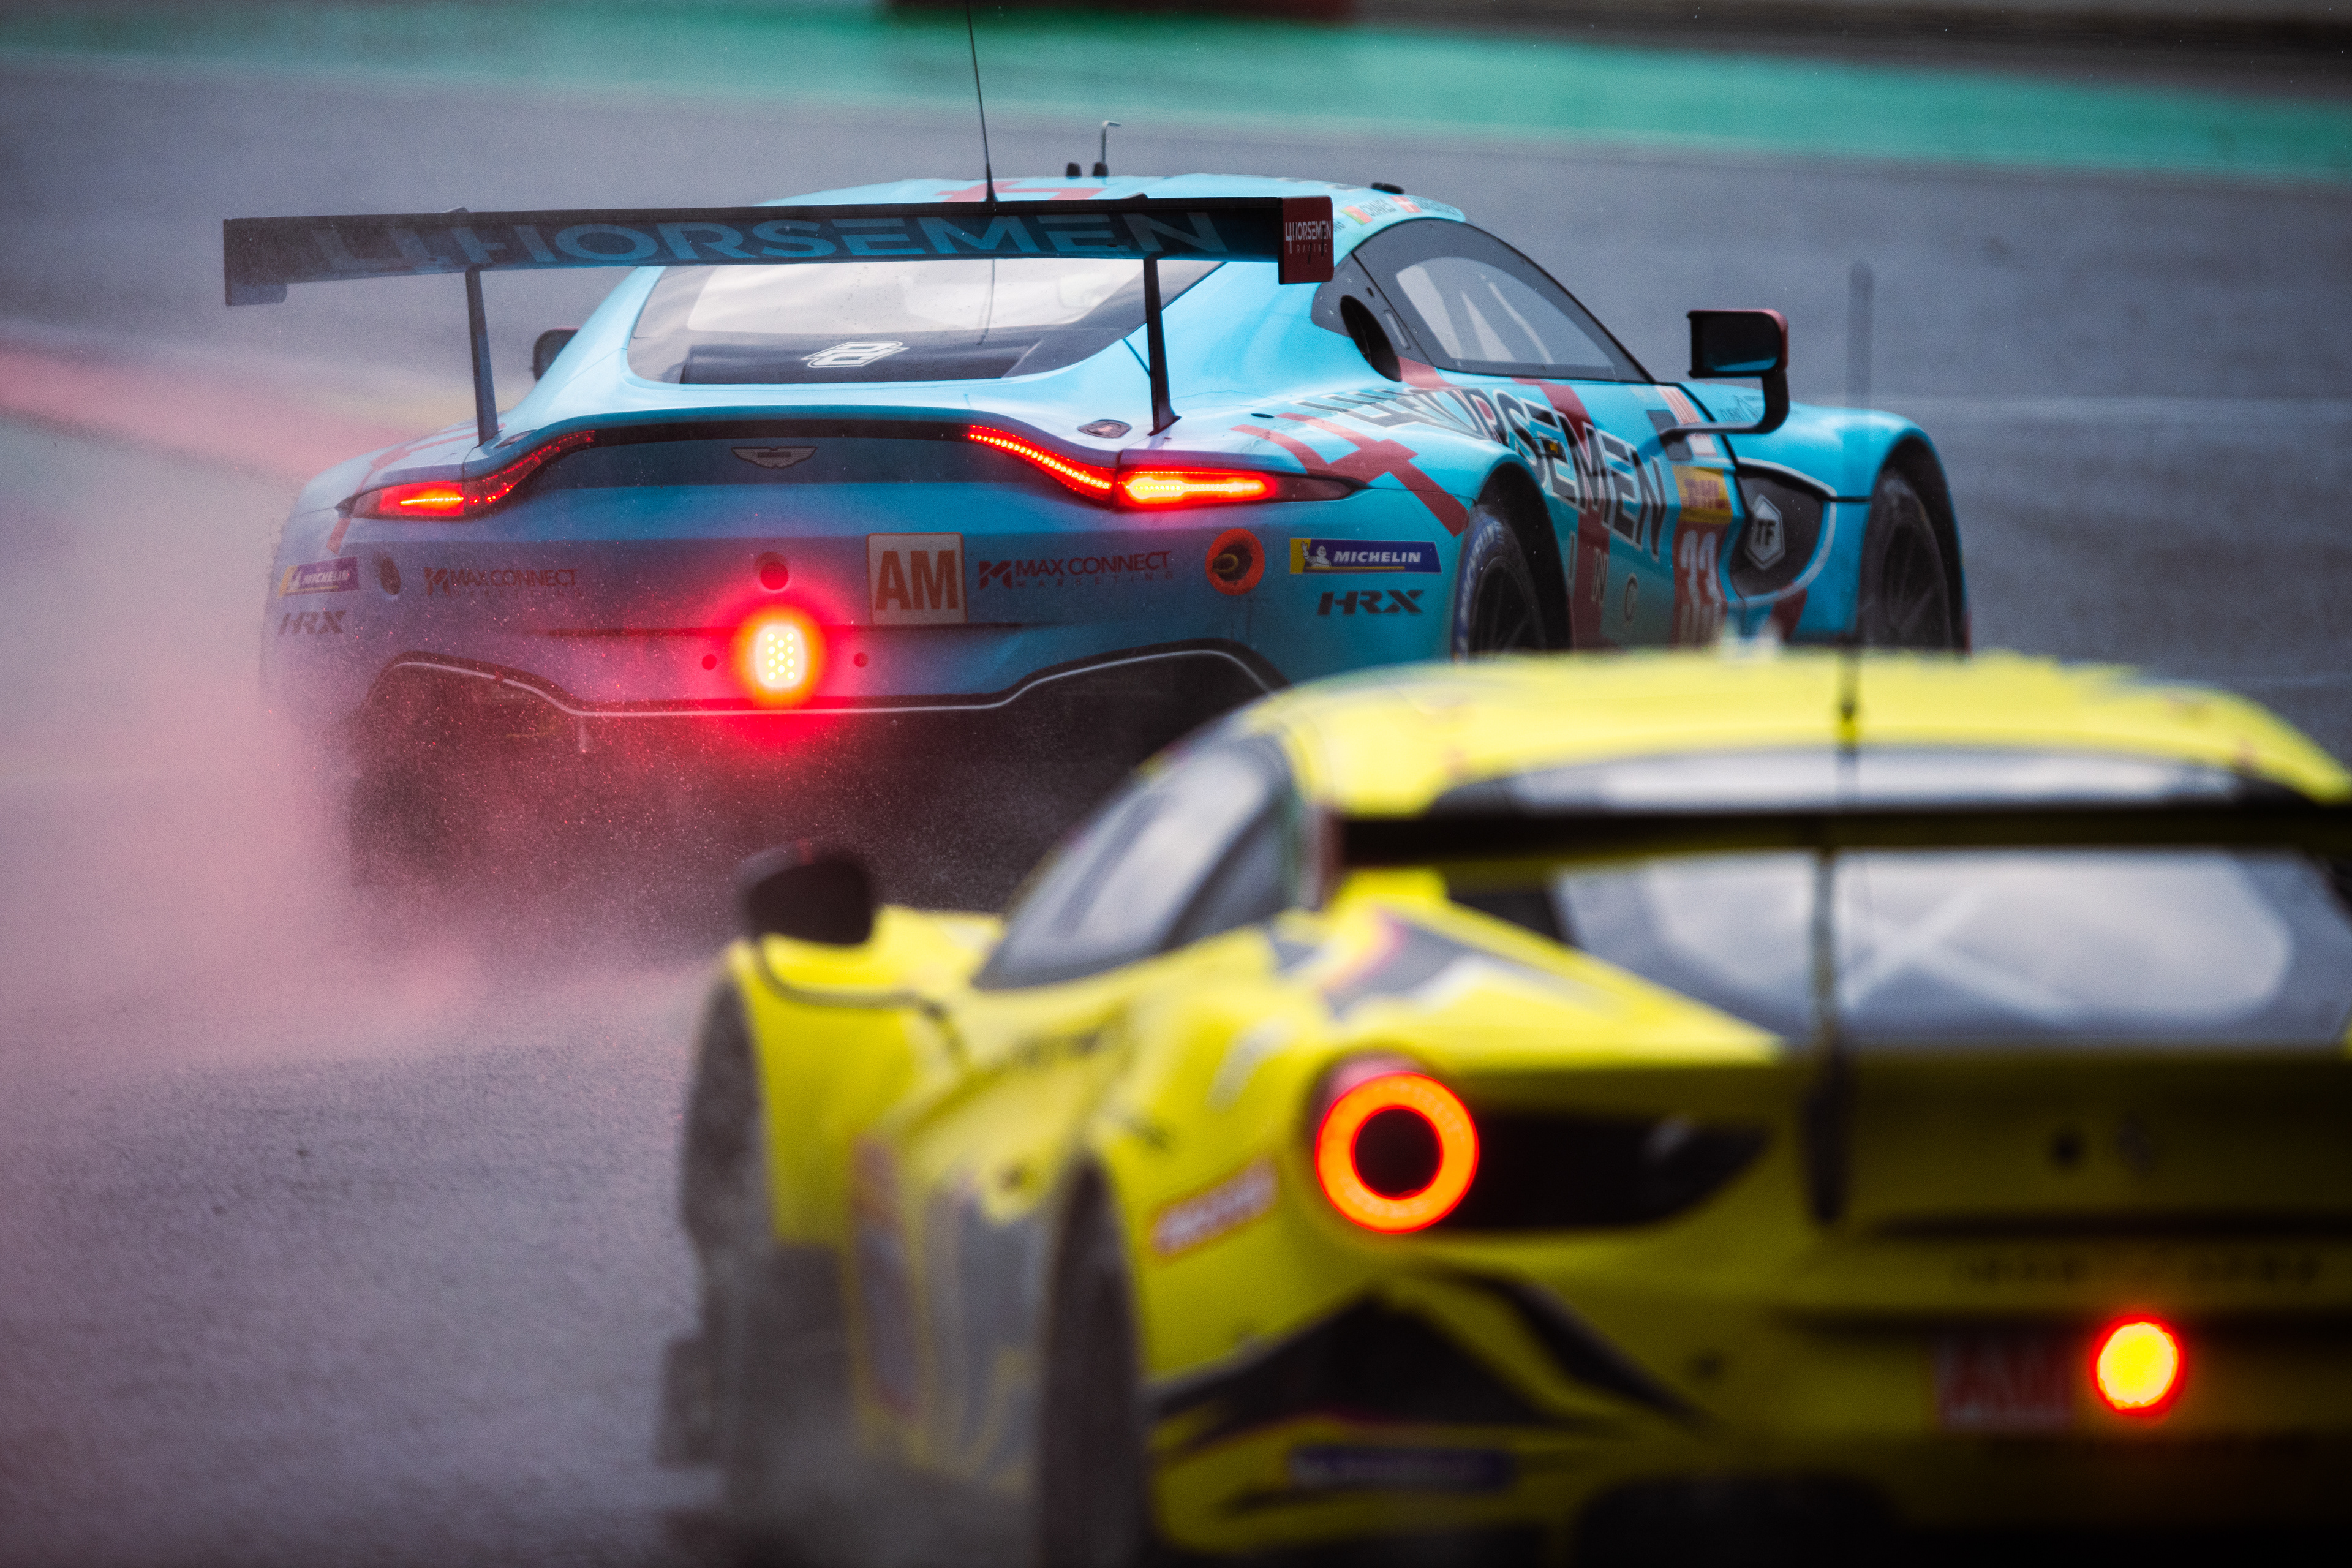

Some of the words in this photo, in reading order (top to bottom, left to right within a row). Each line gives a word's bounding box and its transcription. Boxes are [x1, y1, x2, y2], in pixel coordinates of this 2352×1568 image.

[1015, 560, 1065, 577] MAX
[1068, 551, 1172, 575] CONNECT
[1333, 551, 1422, 563] MICHELIN
[303, 569, 350, 584] MICHELIN
[449, 568, 488, 586] MAX
[490, 568, 578, 587] CONNECT
[874, 550, 959, 611] AM
[1317, 589, 1425, 616] HRX
[277, 609, 347, 635] HRX
